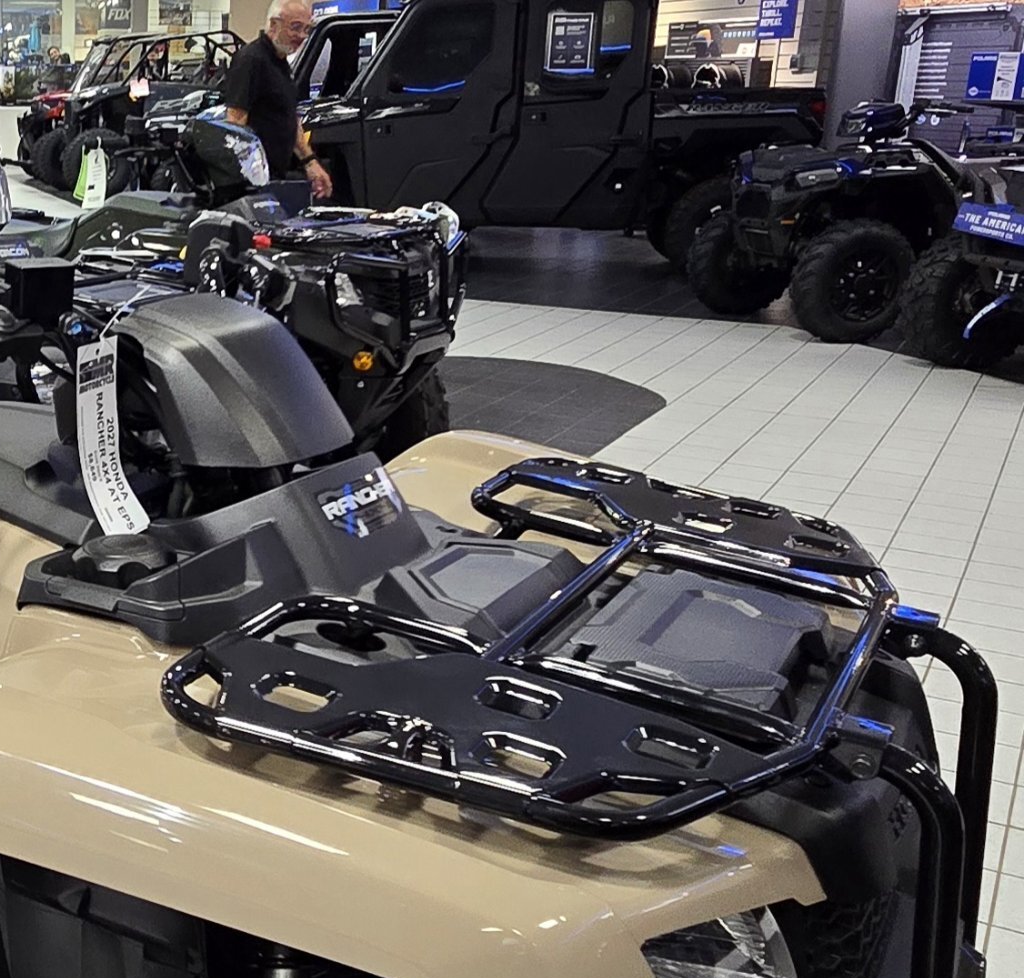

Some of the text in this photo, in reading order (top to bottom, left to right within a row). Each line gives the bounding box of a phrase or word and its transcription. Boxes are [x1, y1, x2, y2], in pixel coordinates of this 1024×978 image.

[107, 8, 132, 20] FOX
[965, 213, 982, 225] THE
[96, 392, 107, 458] RANCHER
[107, 416, 116, 446] 2027
[101, 461, 112, 484] 4X4
[108, 451, 129, 501] HONDA
[108, 488, 121, 502] AT
[117, 506, 135, 530] EPS
